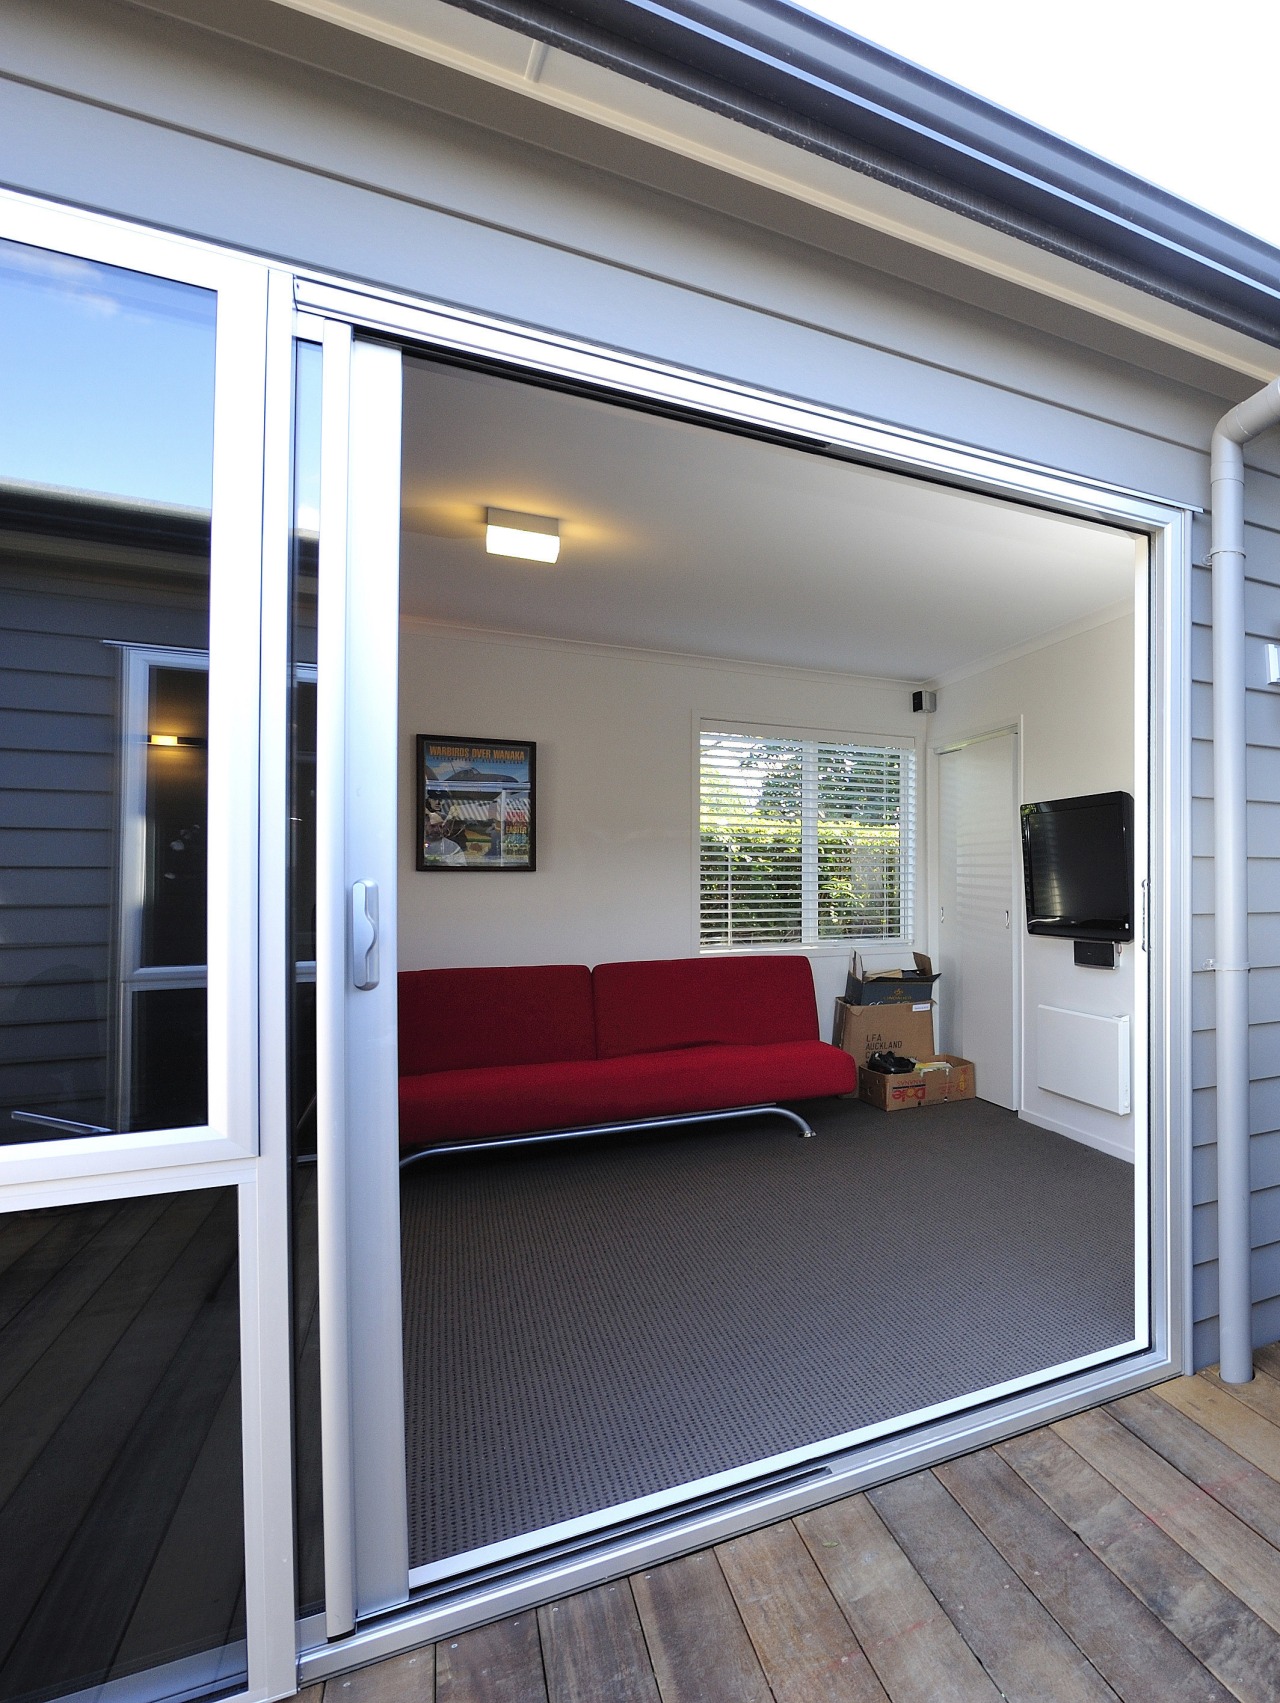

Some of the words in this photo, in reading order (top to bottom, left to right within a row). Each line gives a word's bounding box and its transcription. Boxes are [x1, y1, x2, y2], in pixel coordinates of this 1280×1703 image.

[429, 746, 469, 757] WARBIRDS
[471, 748, 491, 758] OVER
[493, 749, 525, 760] WANAKA
[865, 1041, 903, 1051] AUCKLAND
[892, 1087, 926, 1102] Dole
